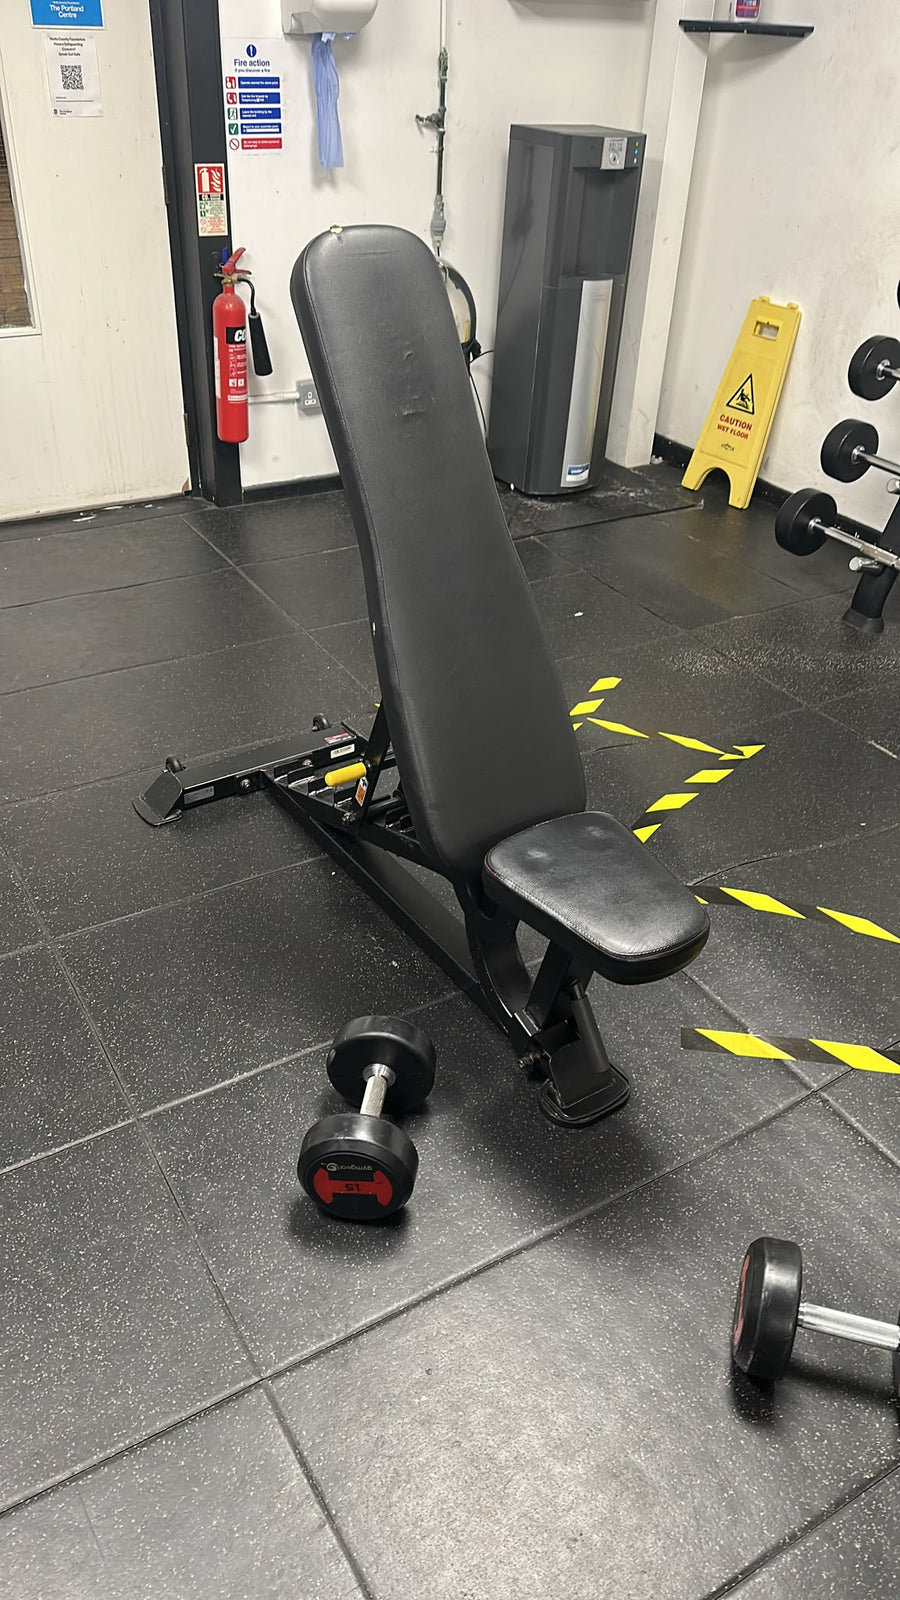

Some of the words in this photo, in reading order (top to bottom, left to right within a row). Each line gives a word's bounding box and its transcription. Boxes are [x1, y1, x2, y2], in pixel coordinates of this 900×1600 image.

[234, 59, 247, 67] Fire
[249, 59, 270, 67] action
[720, 414, 752, 431] CAUTION
[717, 424, 730, 433] WET
[730, 429, 749, 440] FLOOR
[344, 1183, 361, 1191] 15
